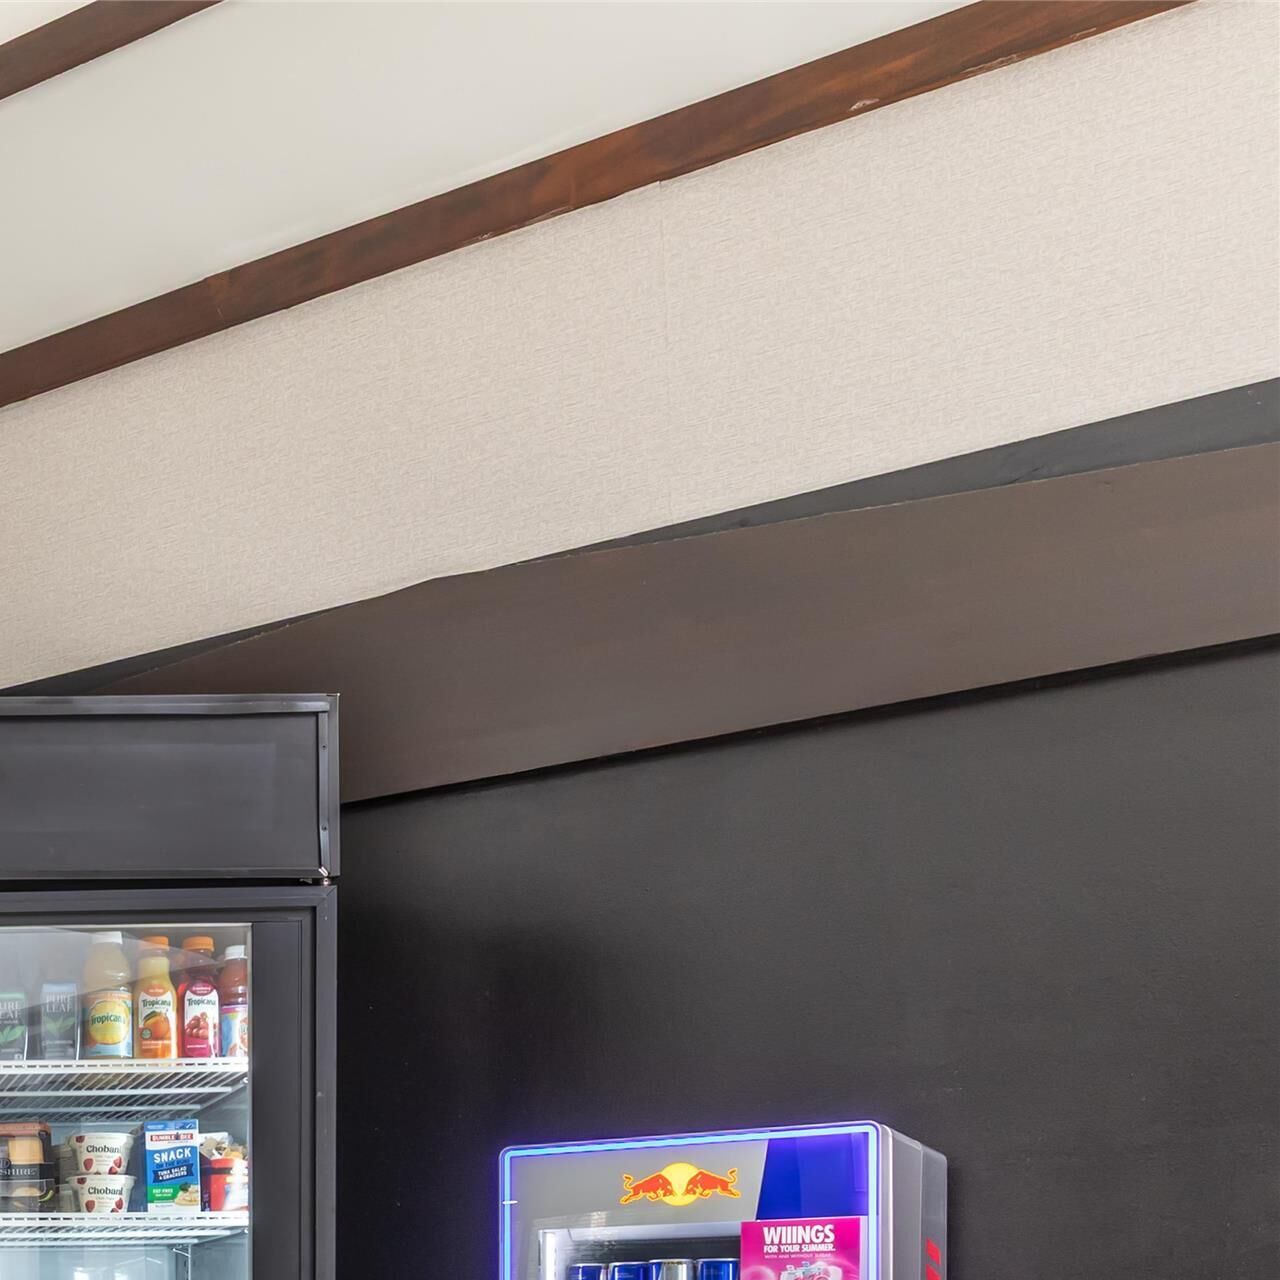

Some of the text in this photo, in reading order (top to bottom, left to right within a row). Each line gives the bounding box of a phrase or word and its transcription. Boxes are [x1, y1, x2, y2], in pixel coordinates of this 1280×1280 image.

[142, 998, 171, 1007] Tropicana
[187, 998, 216, 1007] Tropicana
[91, 1013, 126, 1025] Tropicana
[86, 1145, 122, 1153] Chobani
[153, 1147, 192, 1163] SNACK
[88, 1186, 124, 1195] Chobani
[763, 1225, 835, 1244] WIIINGS
[763, 1243, 836, 1253] FOR YOUR SUMMER.
